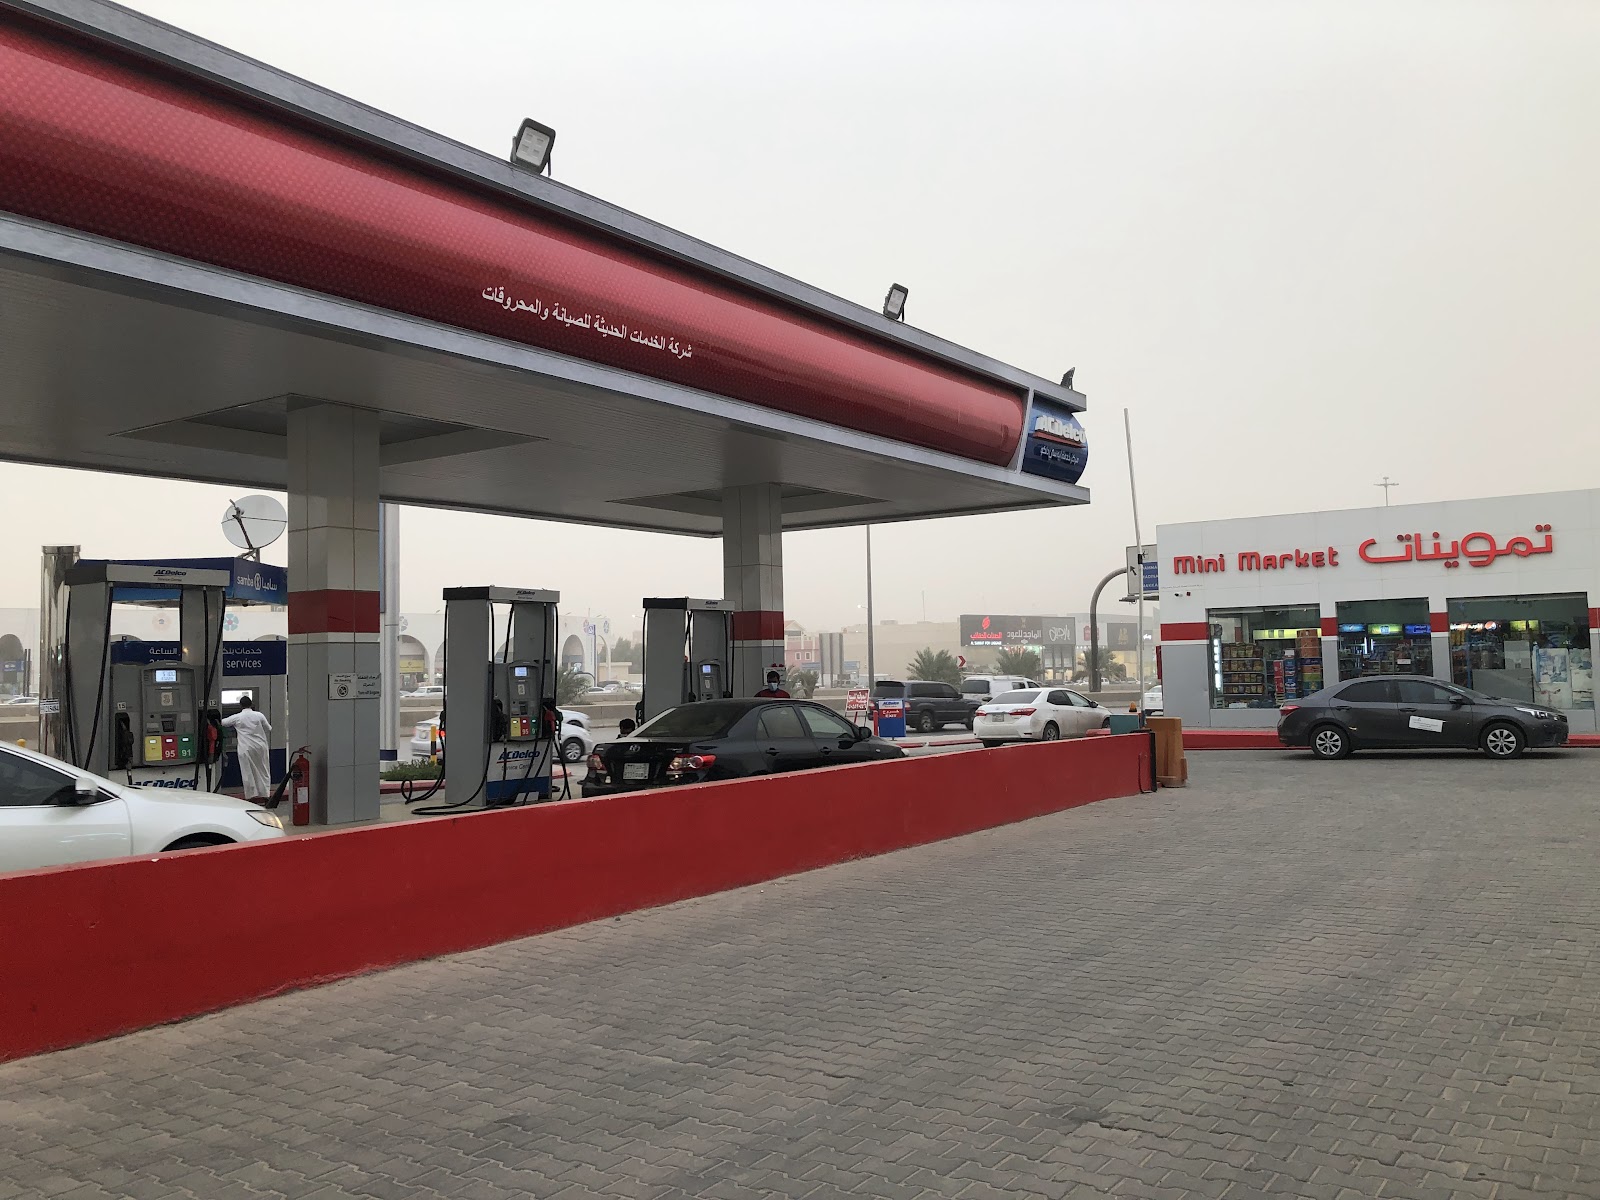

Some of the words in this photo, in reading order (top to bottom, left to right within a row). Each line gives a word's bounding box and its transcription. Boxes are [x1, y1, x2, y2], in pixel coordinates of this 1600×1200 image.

[482, 286, 549, 320] والمحروقات
[552, 302, 591, 328] للصيانة
[593, 314, 627, 340] الحديثة
[630, 330, 666, 350] الخدمات
[668, 337, 693, 359] شركة
[1358, 523, 1553, 569] تموينات
[1173, 553, 1226, 575] Mini
[1238, 546, 1339, 571] Market
[155, 569, 187, 577] ACDelco
[237, 575, 254, 586] samba
[262, 578, 278, 592] سامبا
[1007, 630, 1023, 639] للعود
[1024, 630, 1042, 639] الماجد
[149, 647, 178, 655] الساعة
[235, 647, 262, 655] خدمات
[226, 658, 262, 668] services
[165, 750, 176, 758] 95
[181, 749, 191, 757] 91
[498, 749, 540, 760] ACDelco
